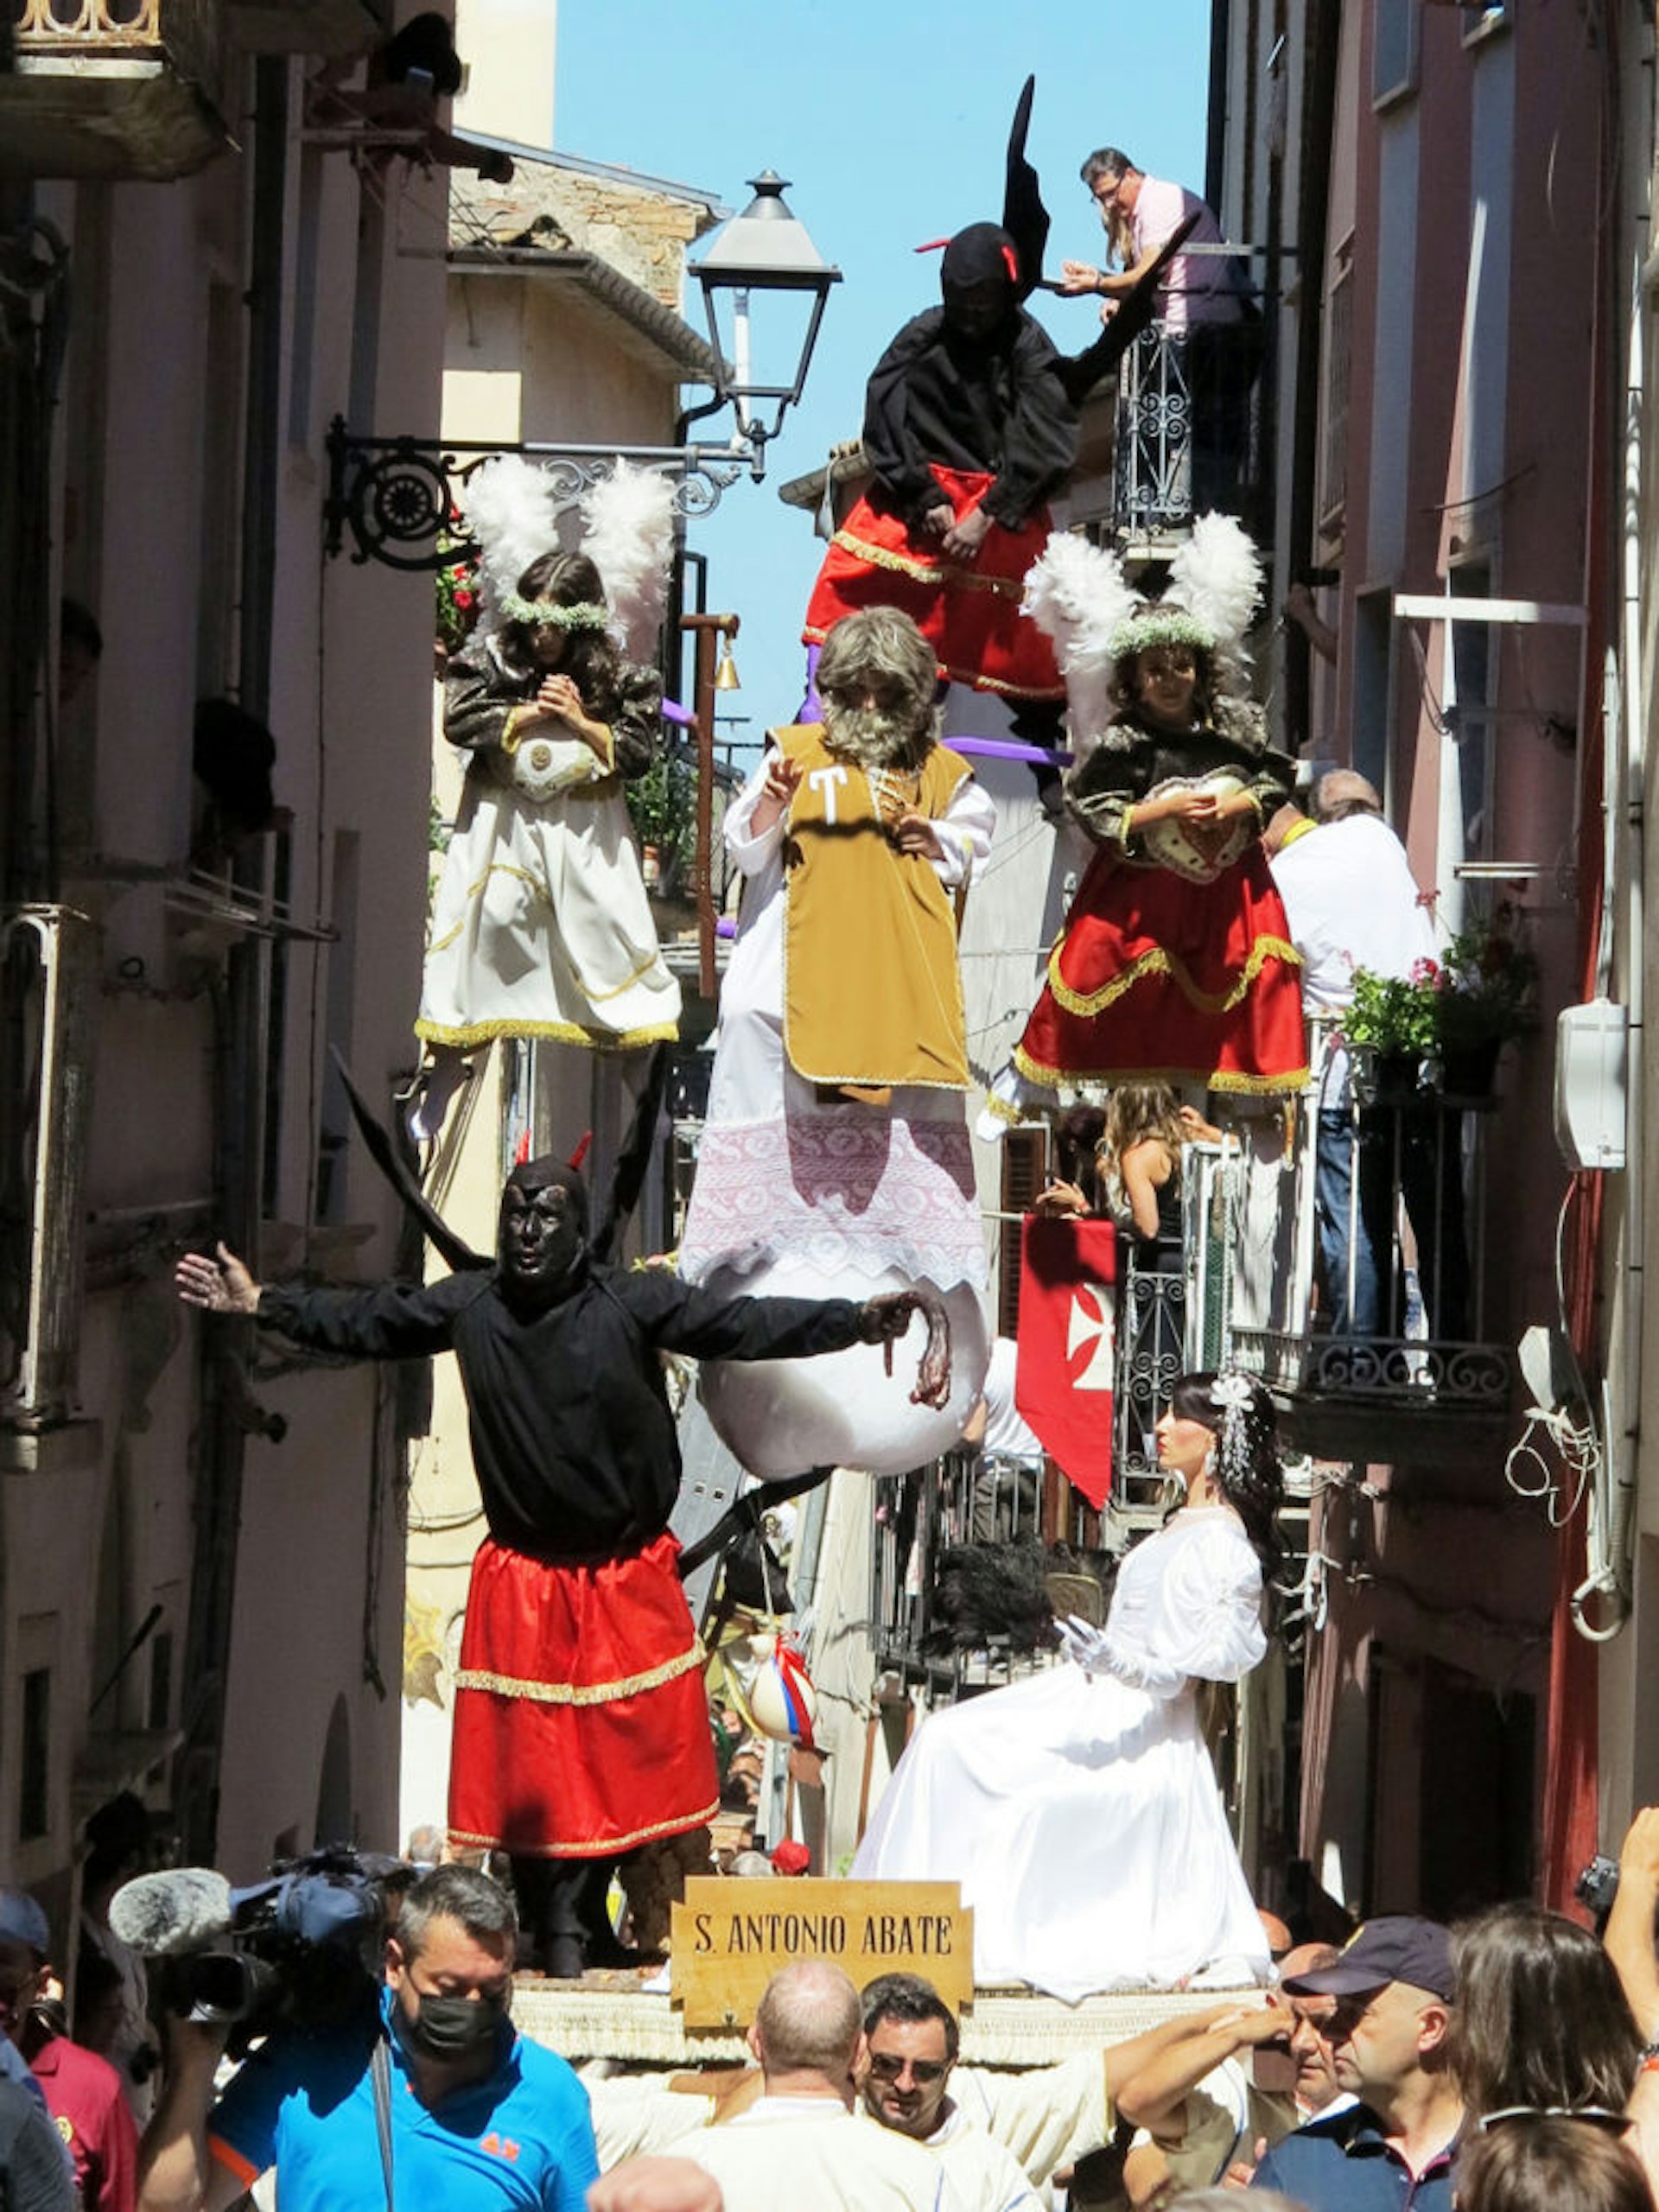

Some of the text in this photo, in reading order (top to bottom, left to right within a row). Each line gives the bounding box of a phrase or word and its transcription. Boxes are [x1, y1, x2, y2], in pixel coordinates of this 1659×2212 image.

[695, 1913, 952, 1955] S. ANTONIO ABATE
